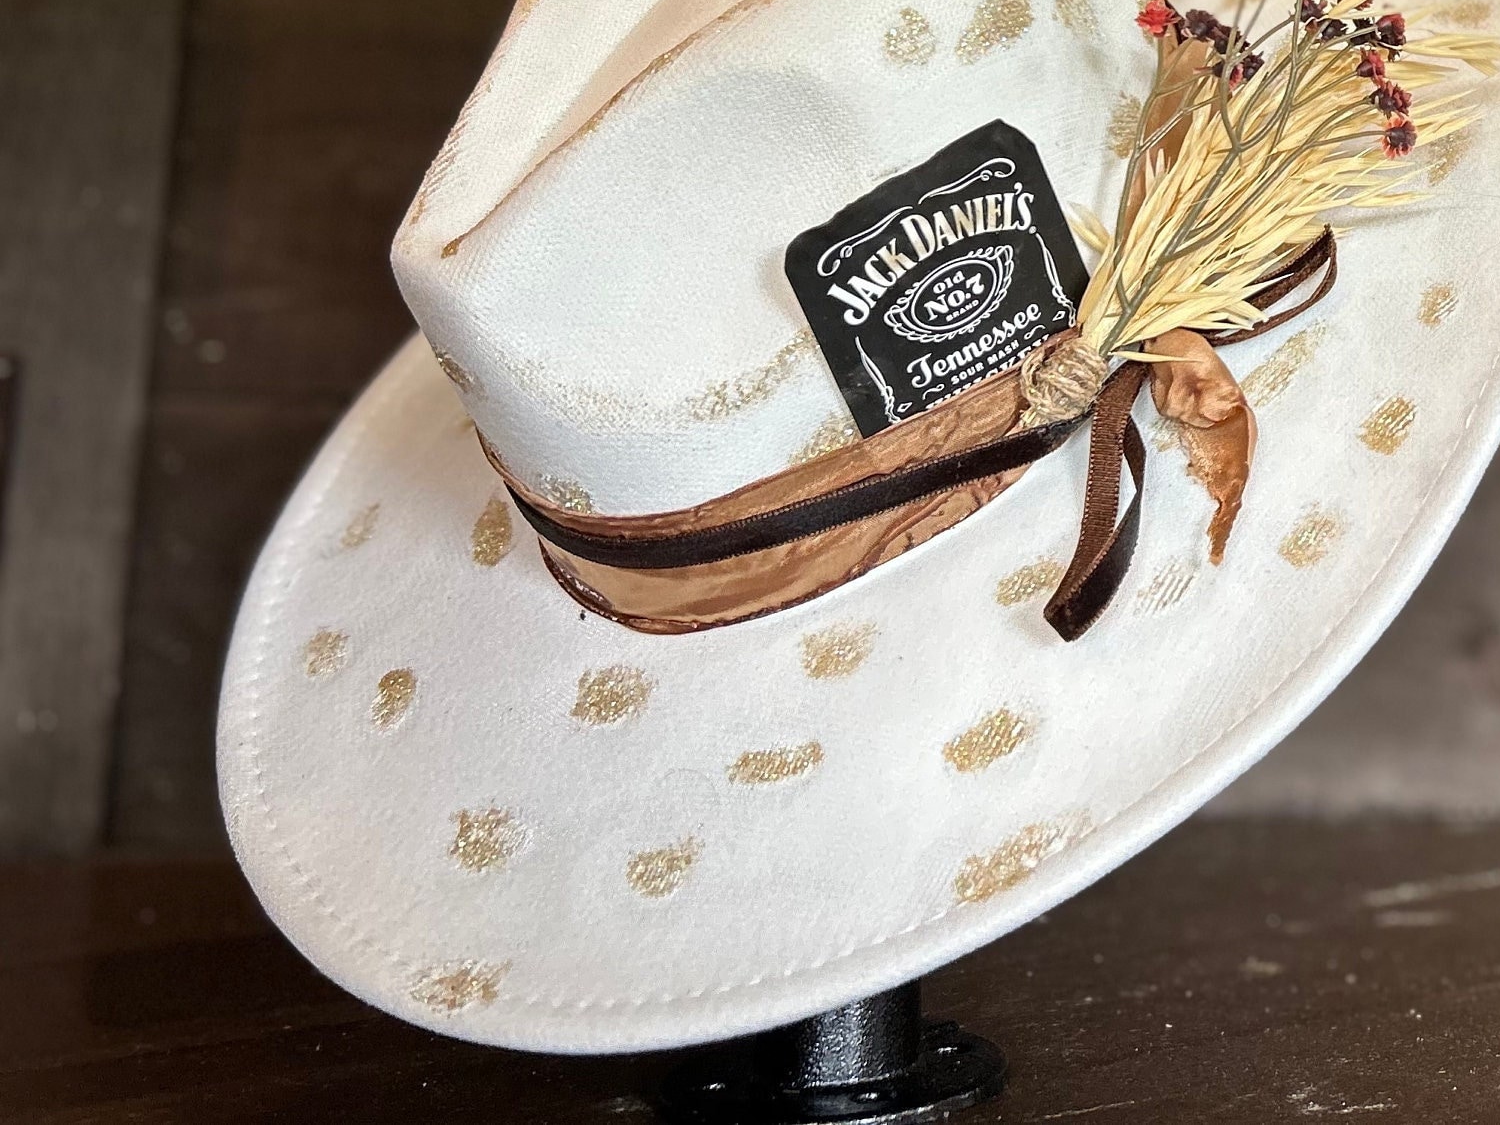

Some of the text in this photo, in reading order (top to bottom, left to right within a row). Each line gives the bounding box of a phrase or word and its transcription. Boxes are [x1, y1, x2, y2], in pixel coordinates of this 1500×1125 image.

[827, 182, 1034, 325] JACK DANIEL'S
[933, 270, 965, 293] Old
[945, 299, 979, 322] BRAND
[907, 304, 1041, 388] Tennessee
[951, 340, 1020, 385] SOUR MASH
